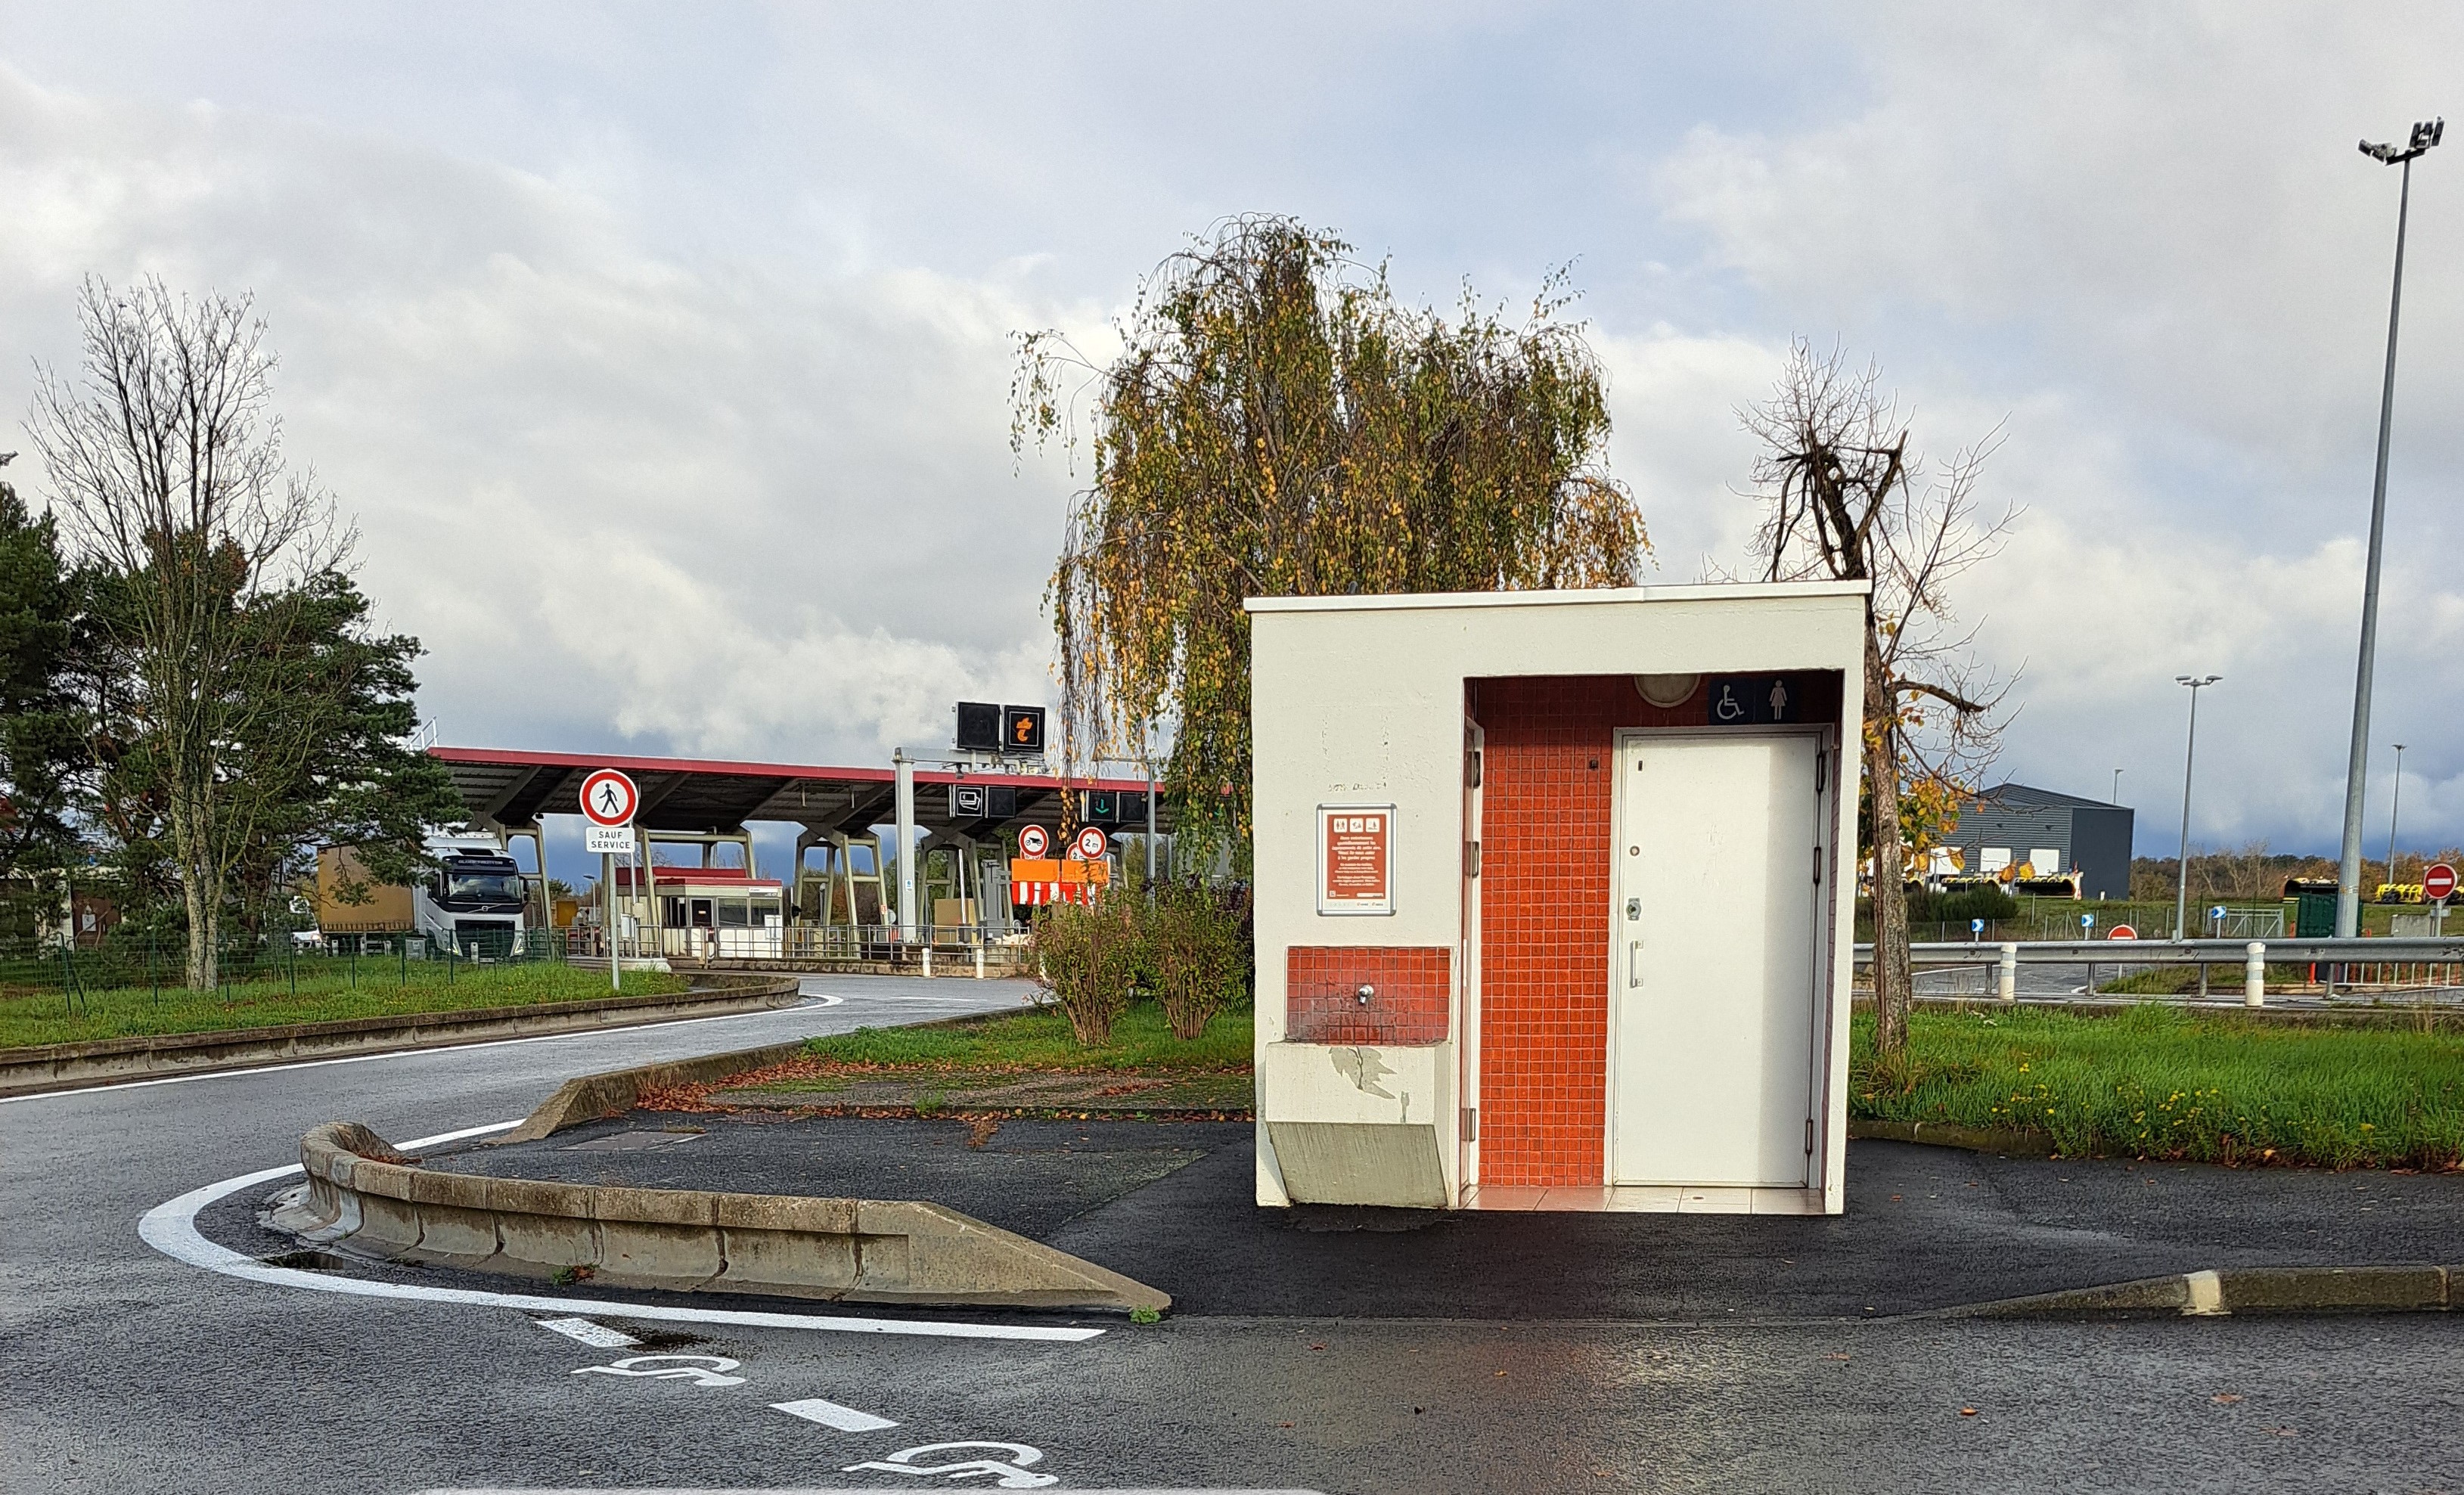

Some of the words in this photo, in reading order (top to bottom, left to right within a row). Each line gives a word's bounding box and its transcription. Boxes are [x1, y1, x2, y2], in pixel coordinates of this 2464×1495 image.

[598, 830, 622, 839] SAUF
[591, 840, 631, 849] SERVICE
[1085, 838, 1091, 847] 2
